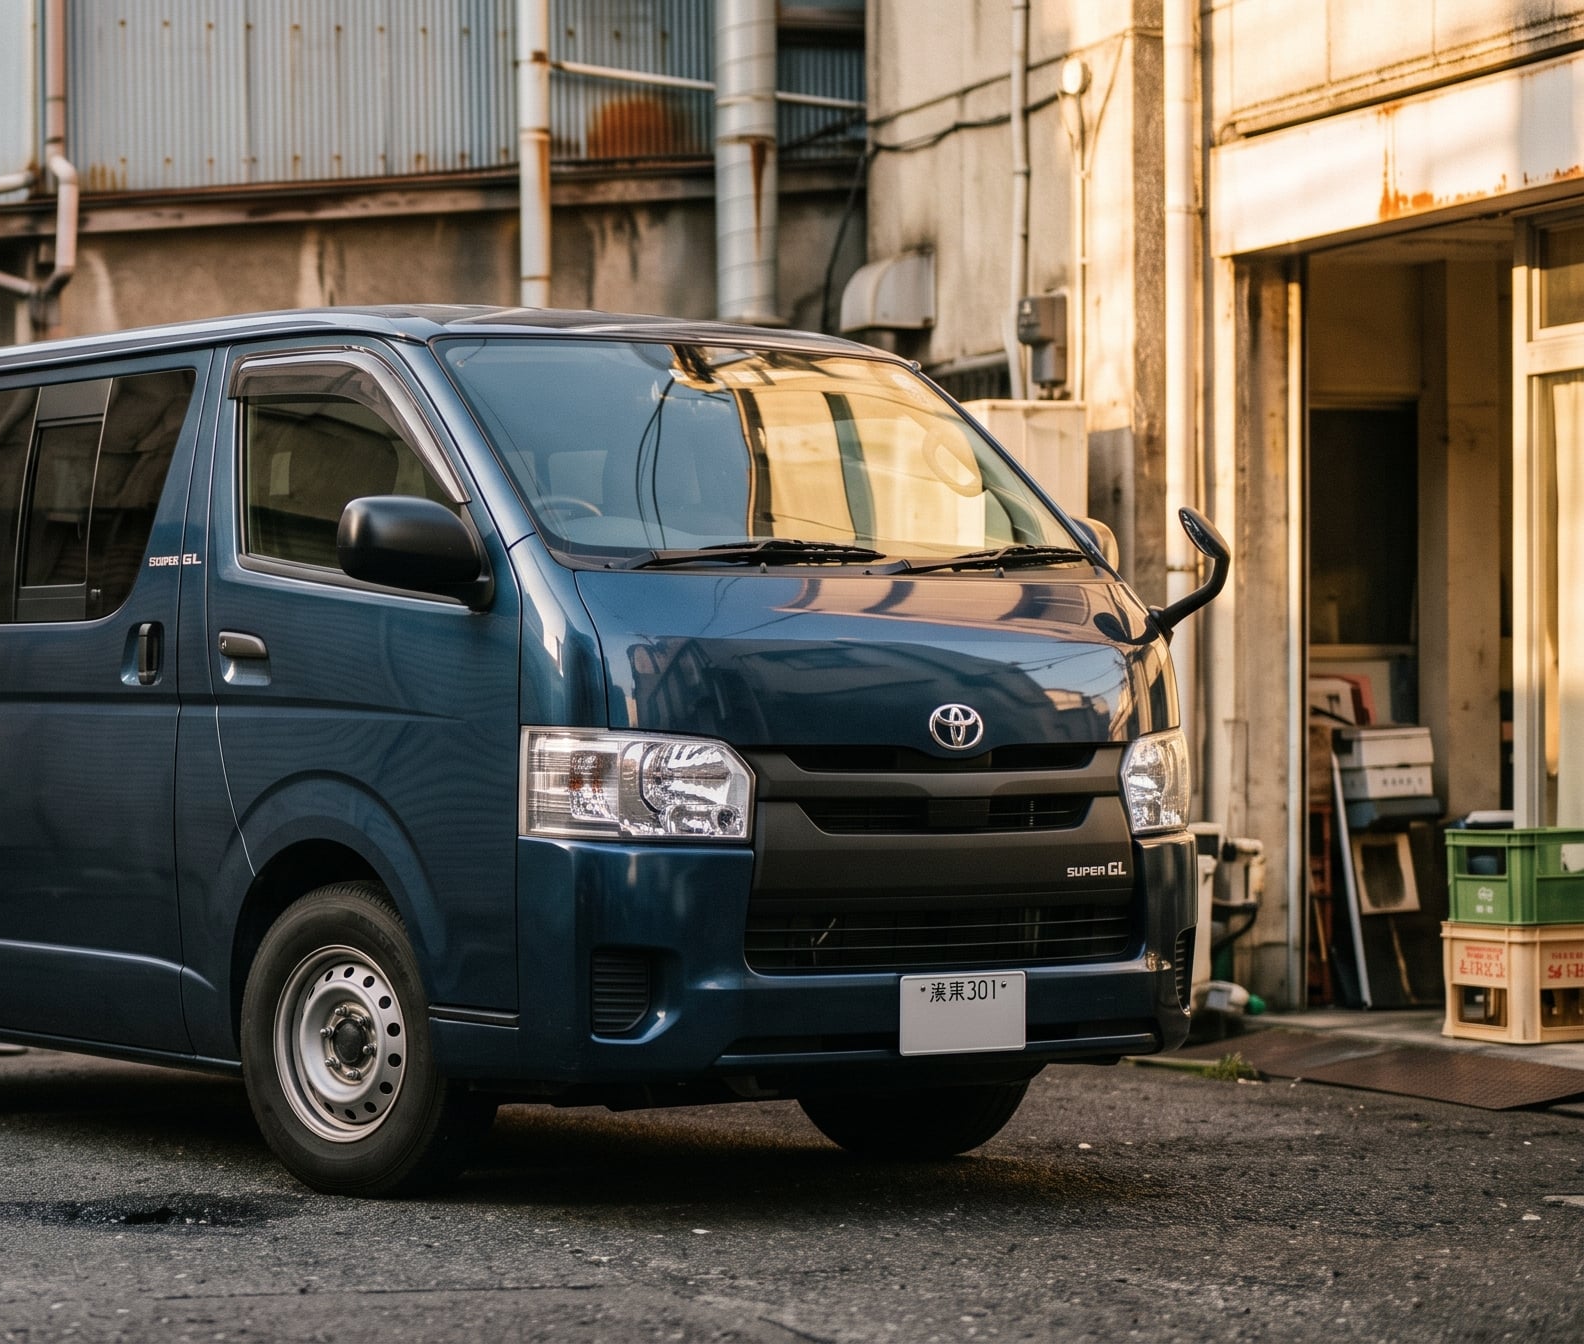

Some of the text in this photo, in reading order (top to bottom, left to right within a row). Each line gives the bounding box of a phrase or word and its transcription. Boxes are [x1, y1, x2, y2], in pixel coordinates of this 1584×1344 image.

[182, 553, 202, 565] GL
[1066, 861, 1127, 878] SUPER GL
